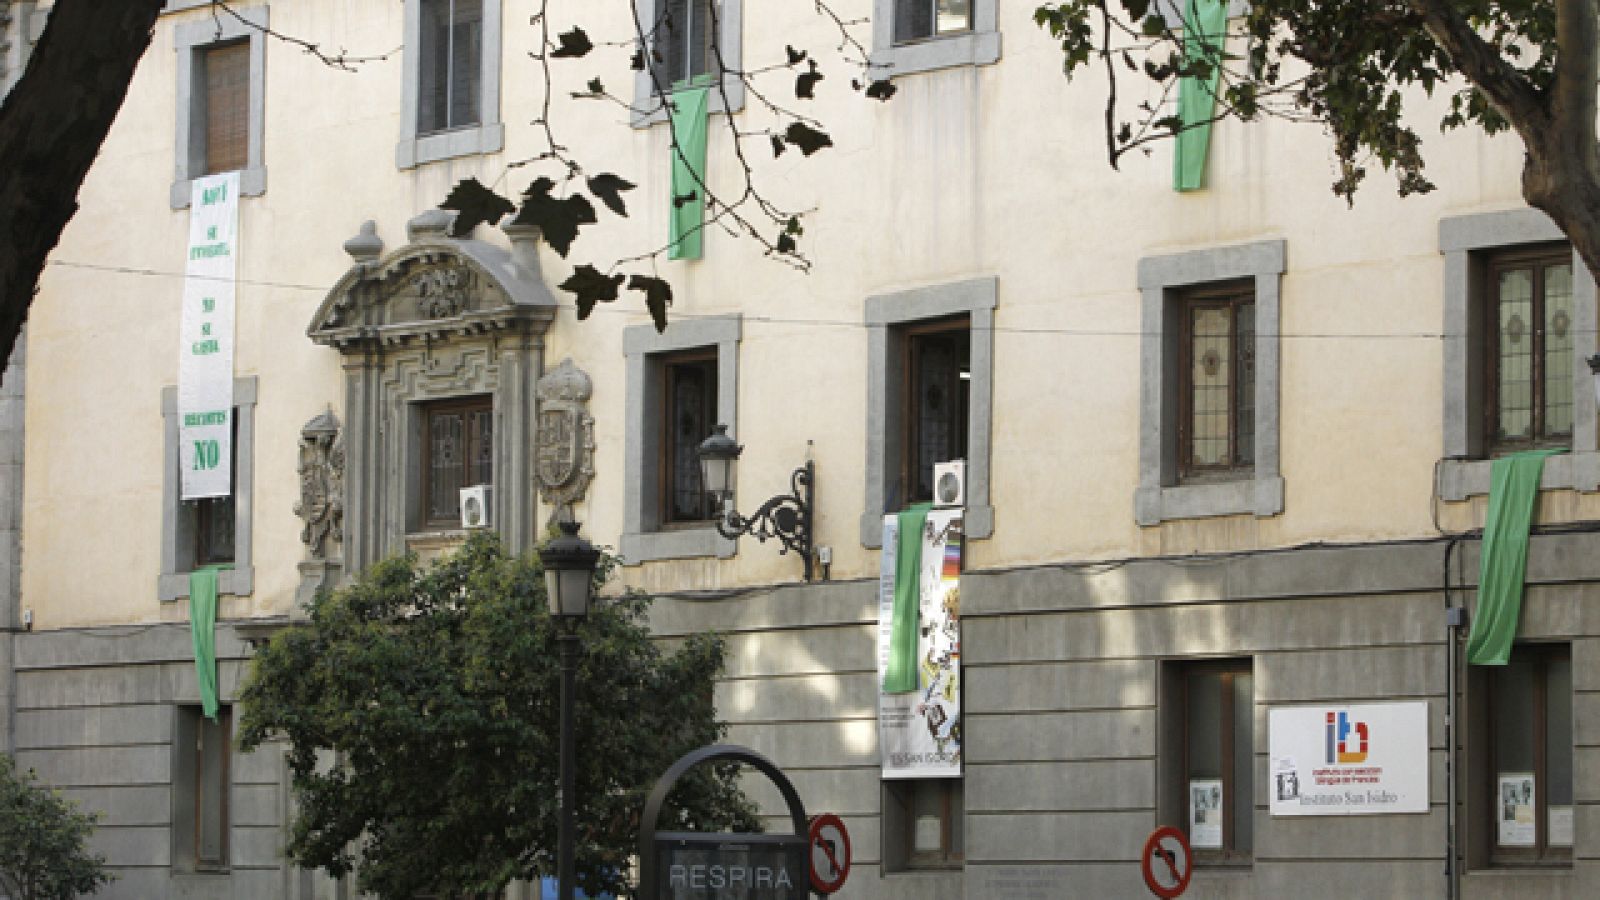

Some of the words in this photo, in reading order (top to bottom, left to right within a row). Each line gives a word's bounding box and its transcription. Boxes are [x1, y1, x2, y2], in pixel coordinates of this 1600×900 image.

[192, 439, 220, 470] NO
[1345, 791, 1365, 805] San
[1367, 789, 1398, 803] Isidro
[669, 864, 792, 888] RESPIRA
